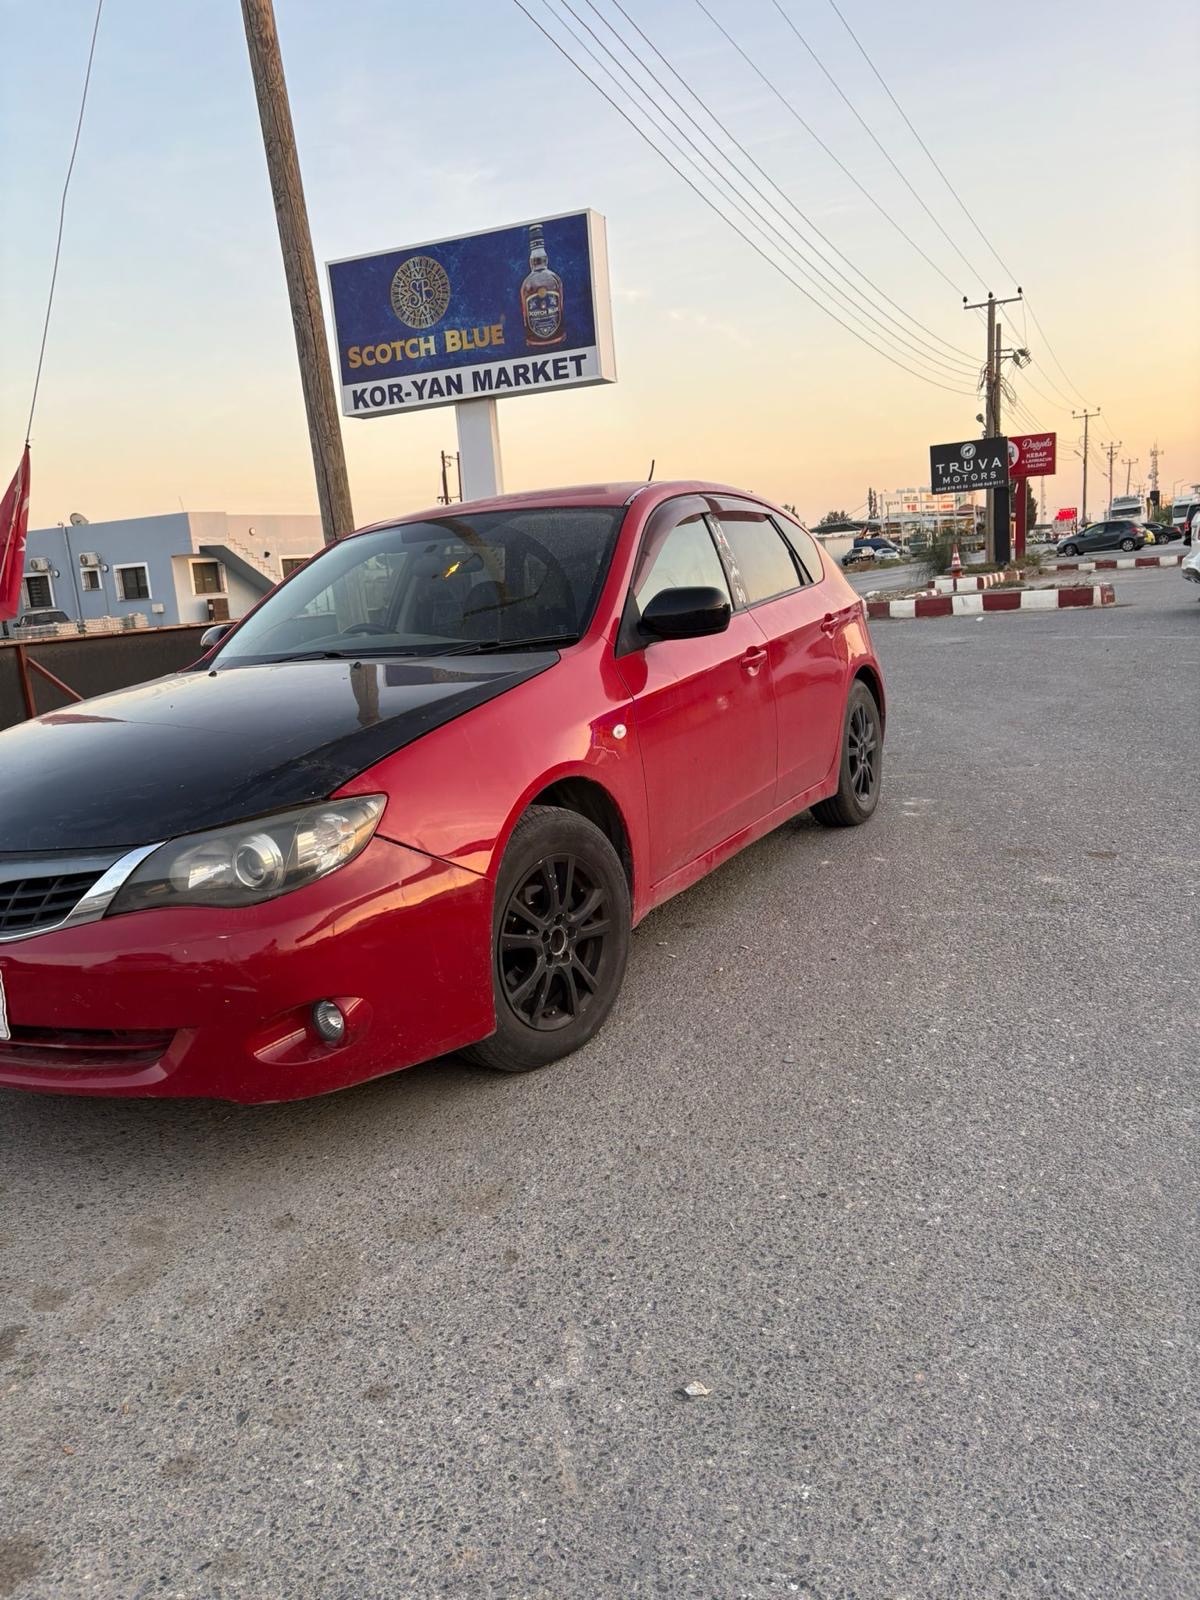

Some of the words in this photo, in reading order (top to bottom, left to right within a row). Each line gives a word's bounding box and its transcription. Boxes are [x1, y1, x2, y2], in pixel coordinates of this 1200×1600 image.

[347, 335, 437, 369] SCOTCH
[443, 323, 505, 353] BLUE
[352, 373, 463, 410] KOR-YAN
[472, 353, 587, 393] MARKET
[935, 457, 1002, 475] TRUVA
[942, 471, 997, 484] MOTORS
